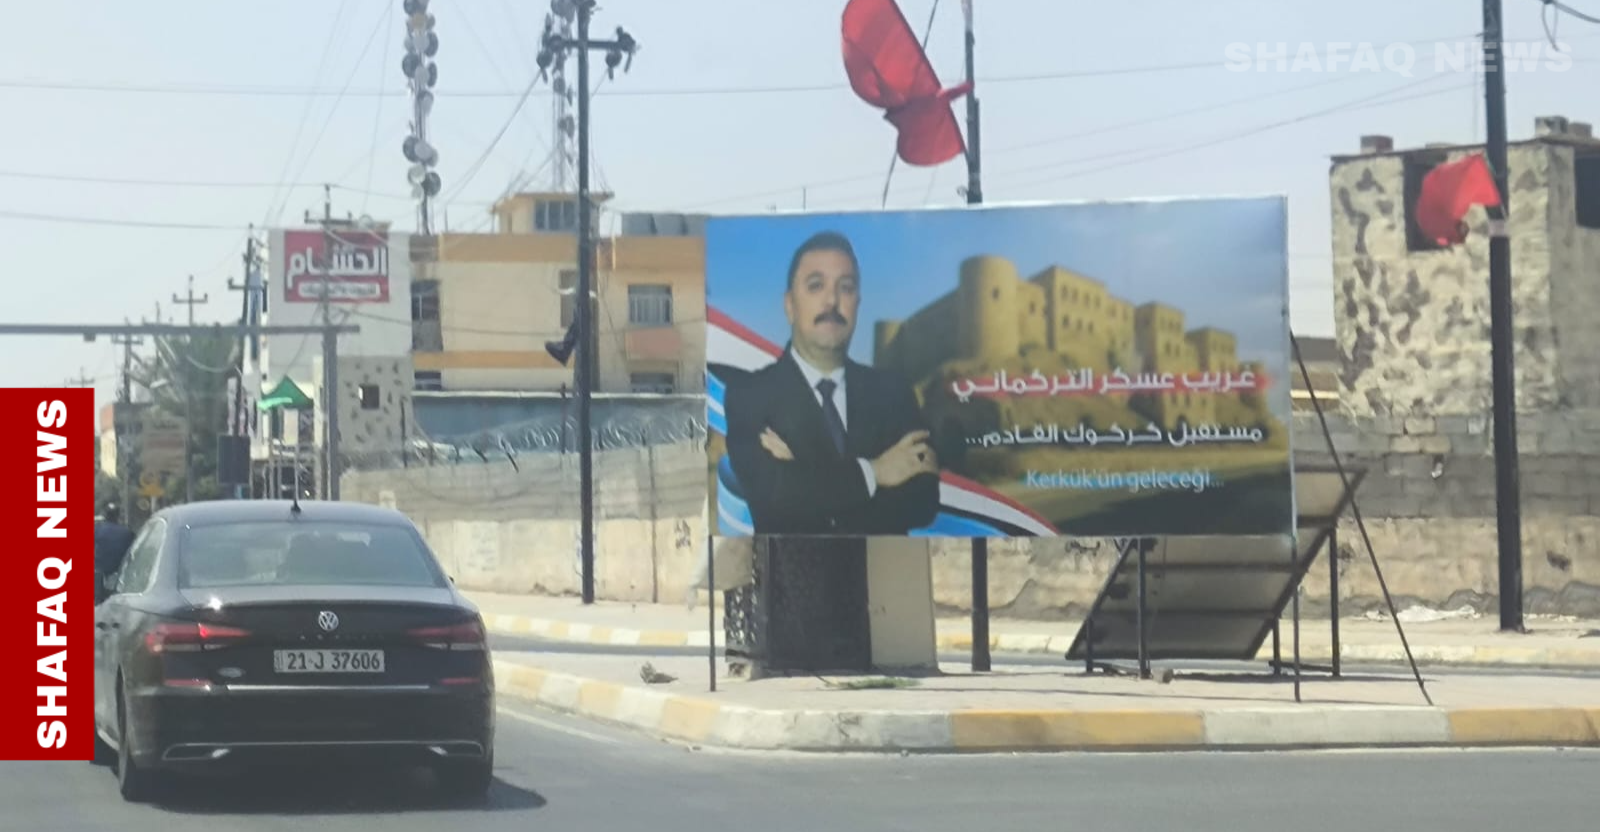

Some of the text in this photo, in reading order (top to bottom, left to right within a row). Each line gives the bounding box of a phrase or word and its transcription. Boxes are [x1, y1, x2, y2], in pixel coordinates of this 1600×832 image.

[952, 365, 1256, 403] غريب عسكر التركماني
[1063, 421, 1162, 446] كركوك
[1167, 422, 1263, 447] مستقبل
[1026, 469, 1122, 489] Kerkük'ün
[331, 652, 381, 670] 37606
